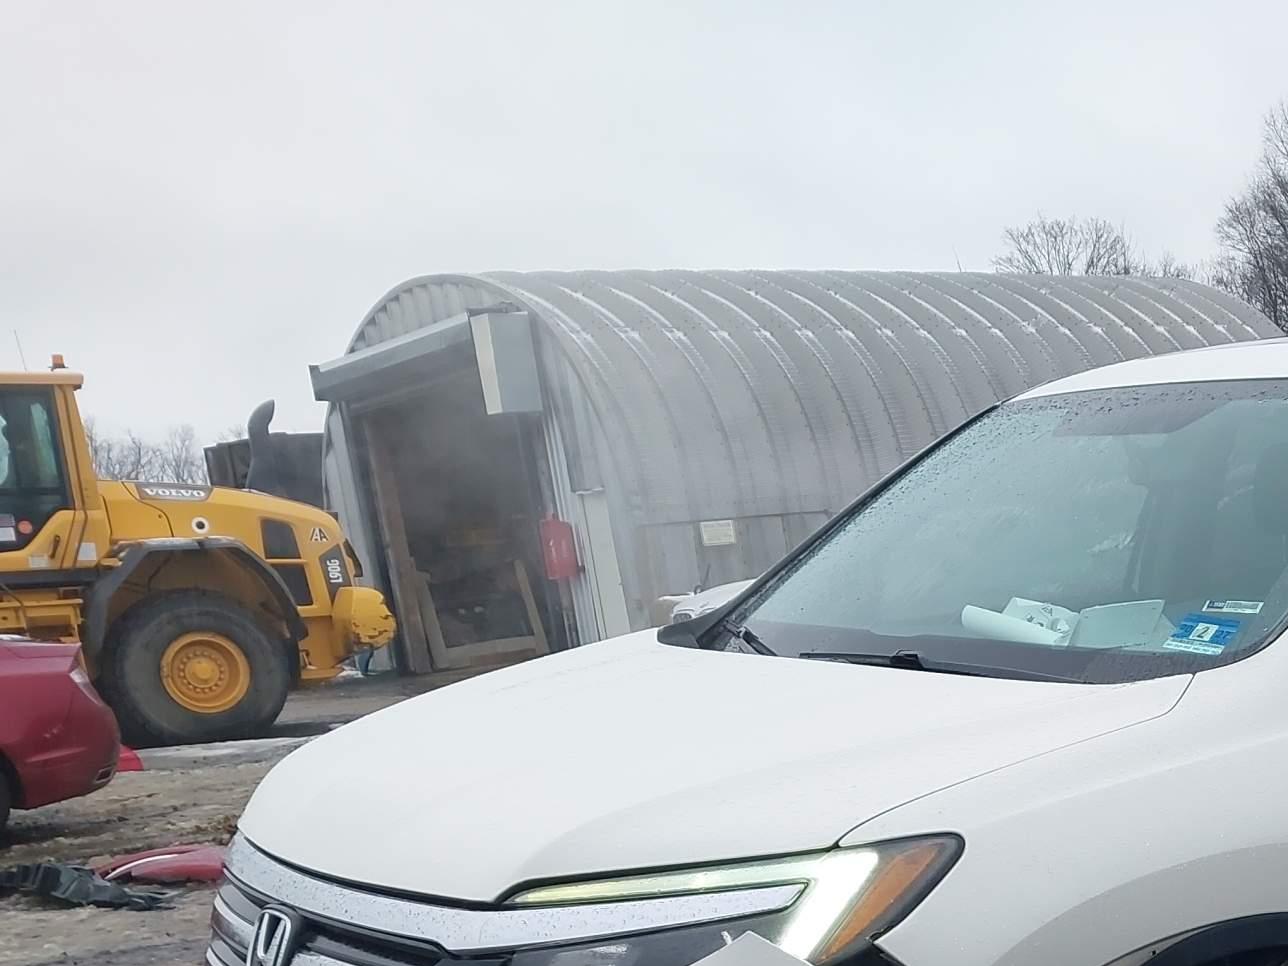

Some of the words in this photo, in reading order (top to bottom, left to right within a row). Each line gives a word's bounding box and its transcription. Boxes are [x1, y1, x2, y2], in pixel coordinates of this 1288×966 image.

[142, 487, 206, 498] VOLVO
[326, 558, 343, 583] L90G
[1196, 625, 1210, 638] 2
